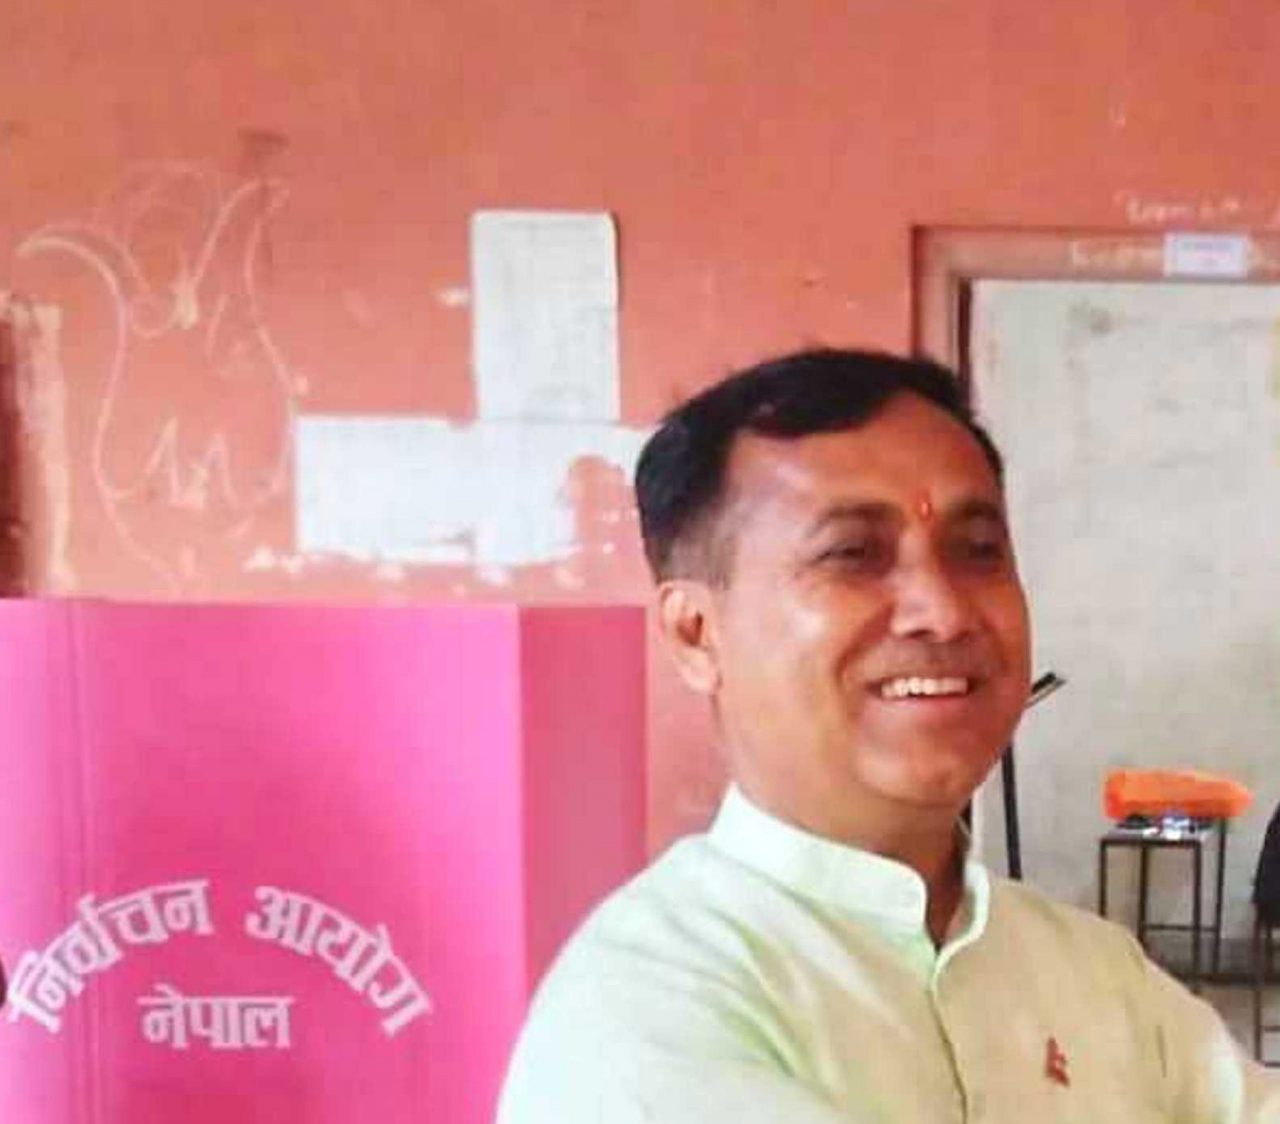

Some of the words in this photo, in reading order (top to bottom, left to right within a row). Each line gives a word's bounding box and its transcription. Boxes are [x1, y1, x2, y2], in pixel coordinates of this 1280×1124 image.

[7, 880, 213, 1033] निर्वाचन
[246, 886, 431, 1036] आयोग
[137, 983, 295, 1050] नेपाल
